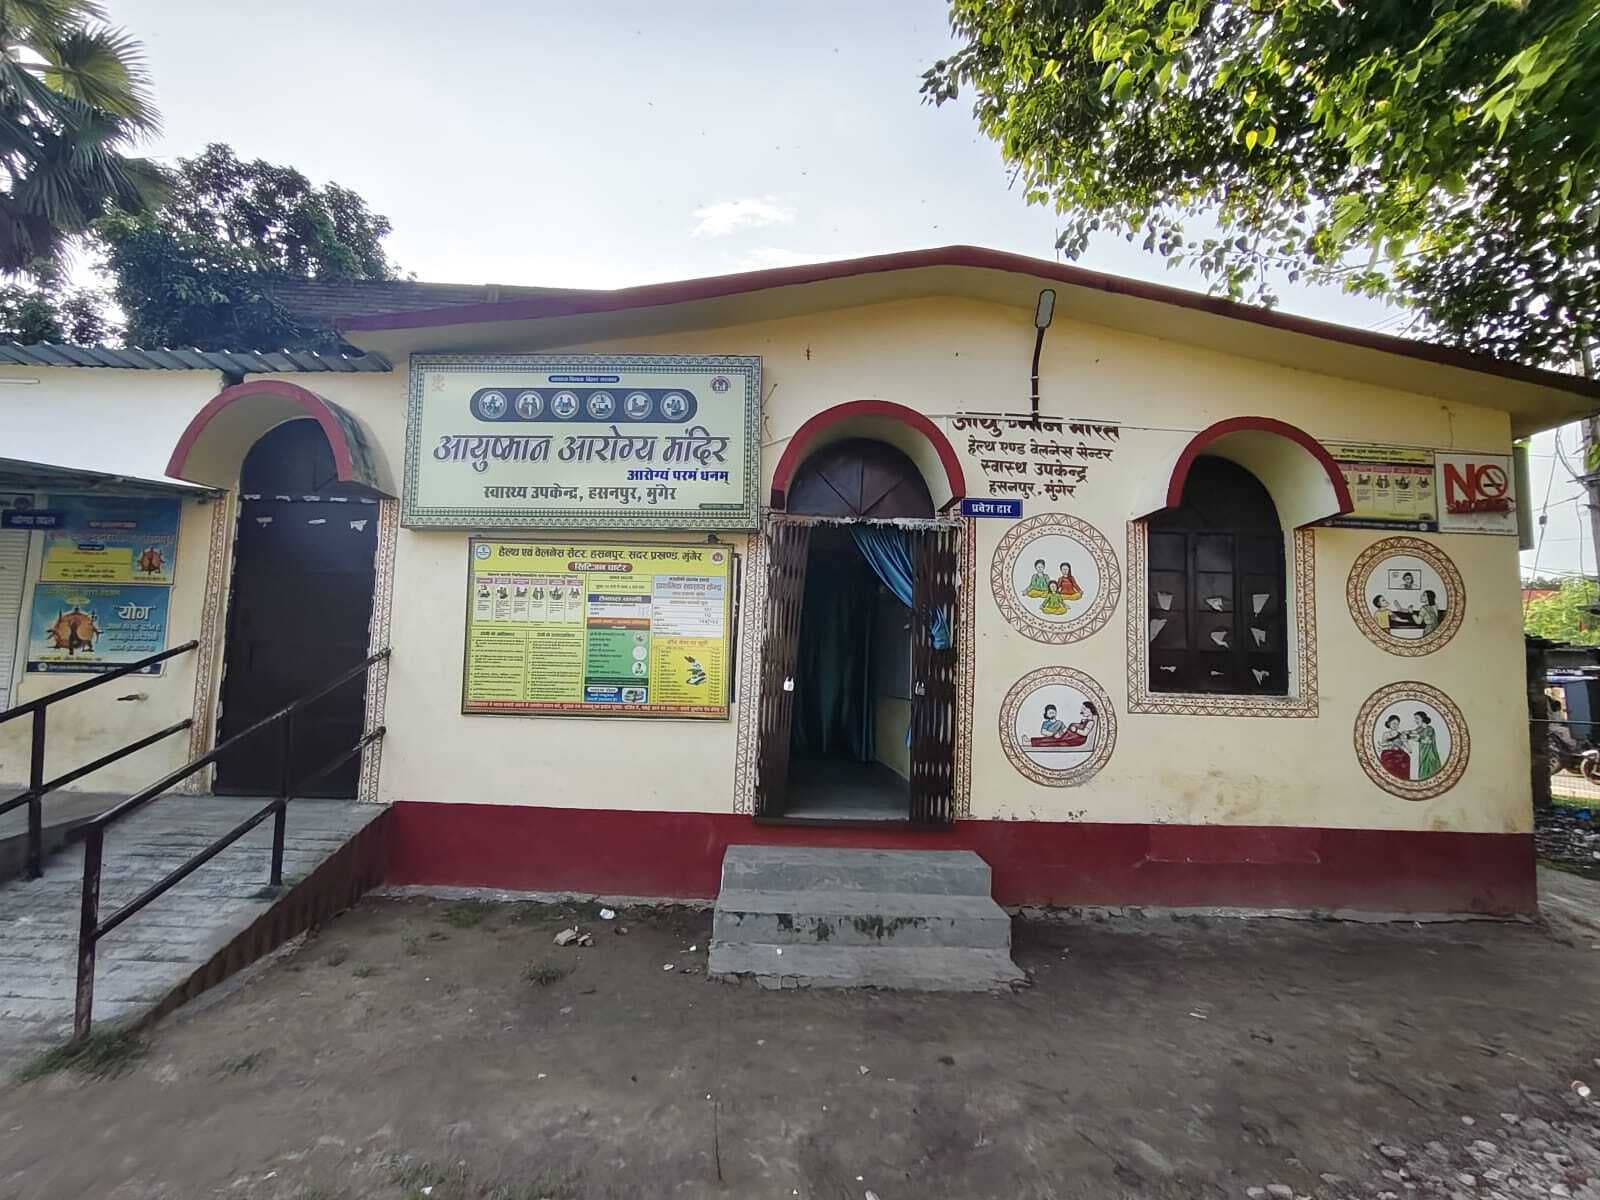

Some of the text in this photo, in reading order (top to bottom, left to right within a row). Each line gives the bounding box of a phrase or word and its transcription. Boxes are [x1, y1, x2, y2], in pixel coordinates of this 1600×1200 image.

[433, 425, 730, 472] आयुष्मान आरोग्य मंदिर
[967, 435, 1113, 461] हेल्थ एण्ड वेलनेस सेन्टर
[1033, 459, 1088, 483] उपकेन्द्र
[483, 485, 528, 499] स्वास्थ्य
[588, 486, 642, 504] हसनपुर,
[646, 484, 678, 504] मुंगेर
[1043, 480, 1076, 501] मुंगेर
[971, 502, 994, 513] प्रवेश
[535, 546, 564, 558] वेलनेस
[682, 550, 703, 562] मुंगेर
